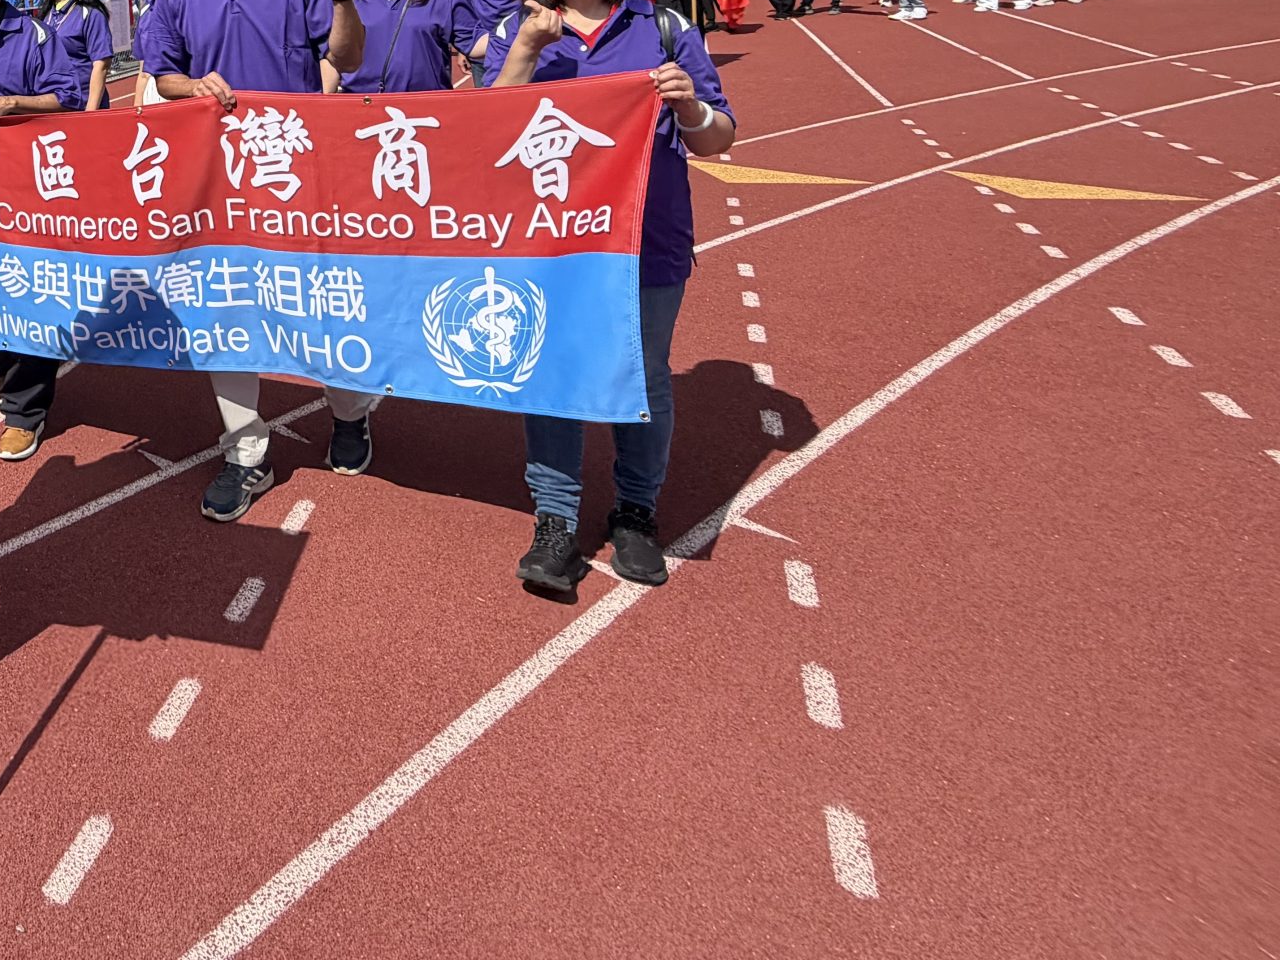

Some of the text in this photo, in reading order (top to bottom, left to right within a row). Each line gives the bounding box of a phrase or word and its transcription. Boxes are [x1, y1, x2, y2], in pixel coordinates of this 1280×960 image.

[147, 207, 214, 239] San
[225, 197, 414, 239] Francisco
[429, 204, 514, 248] Bay
[525, 202, 612, 239] Area
[70, 319, 251, 360] Participate
[261, 320, 372, 373] WHO
